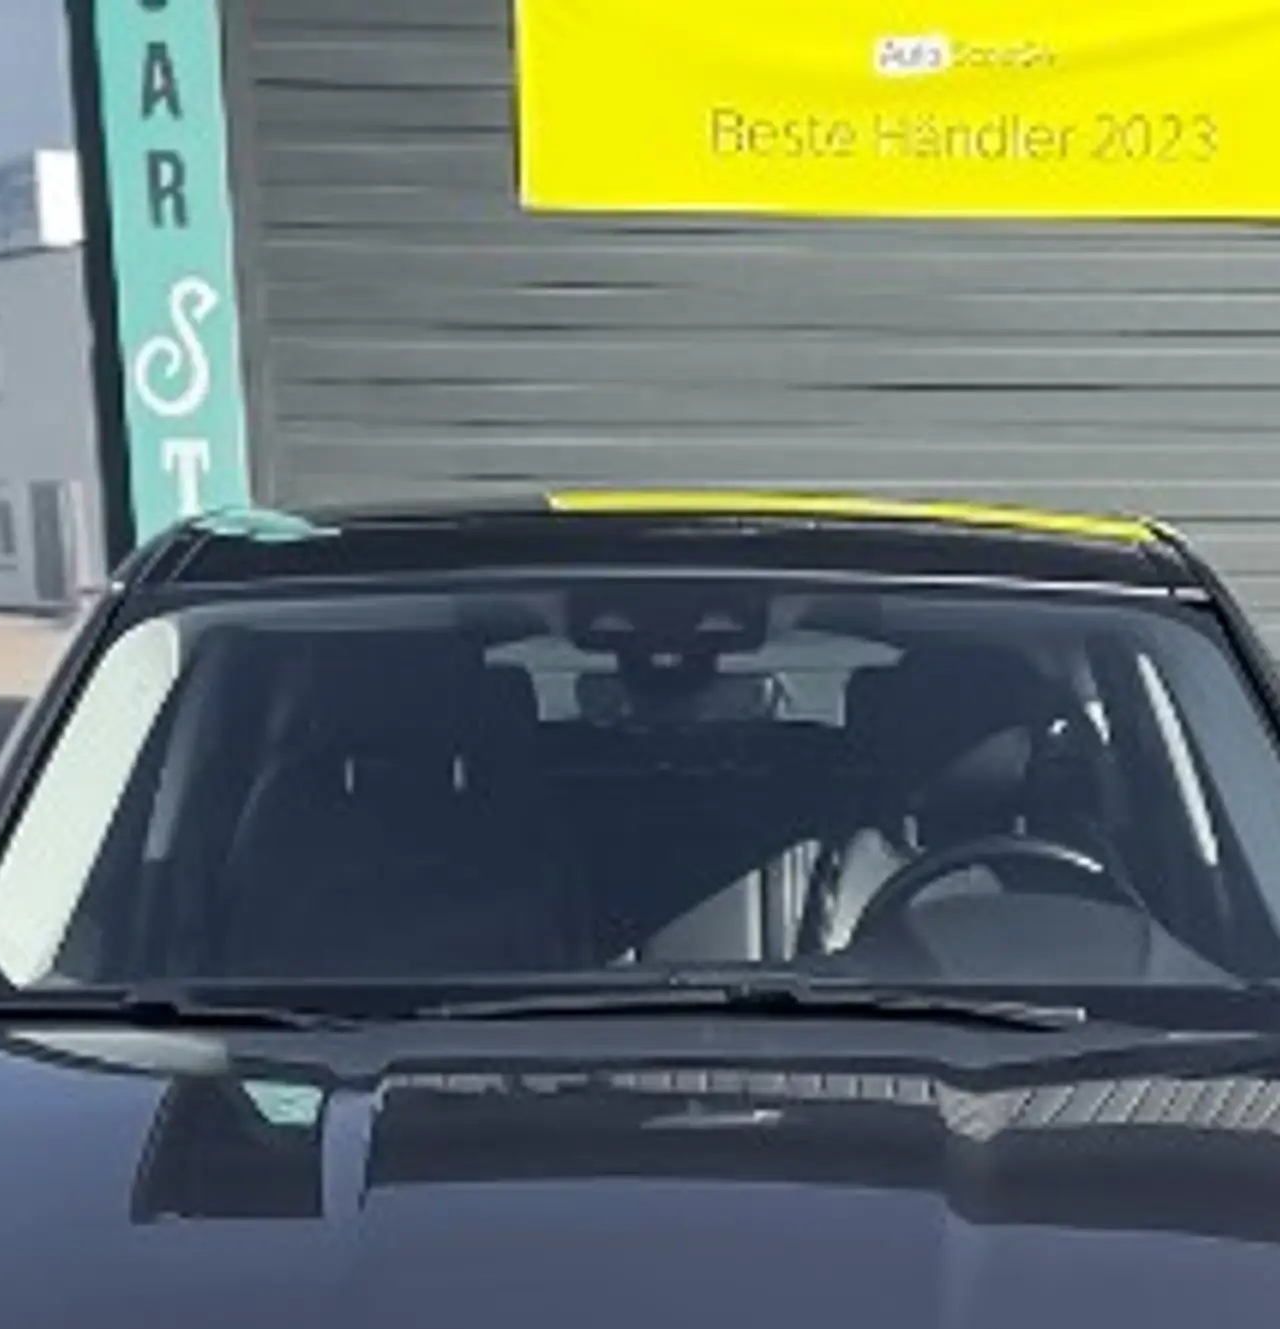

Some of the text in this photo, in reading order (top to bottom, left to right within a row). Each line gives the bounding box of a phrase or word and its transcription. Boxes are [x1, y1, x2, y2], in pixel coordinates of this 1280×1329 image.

[137, 0, 188, 229] AR
[711, 107, 1220, 164] Beste Händler 2023
